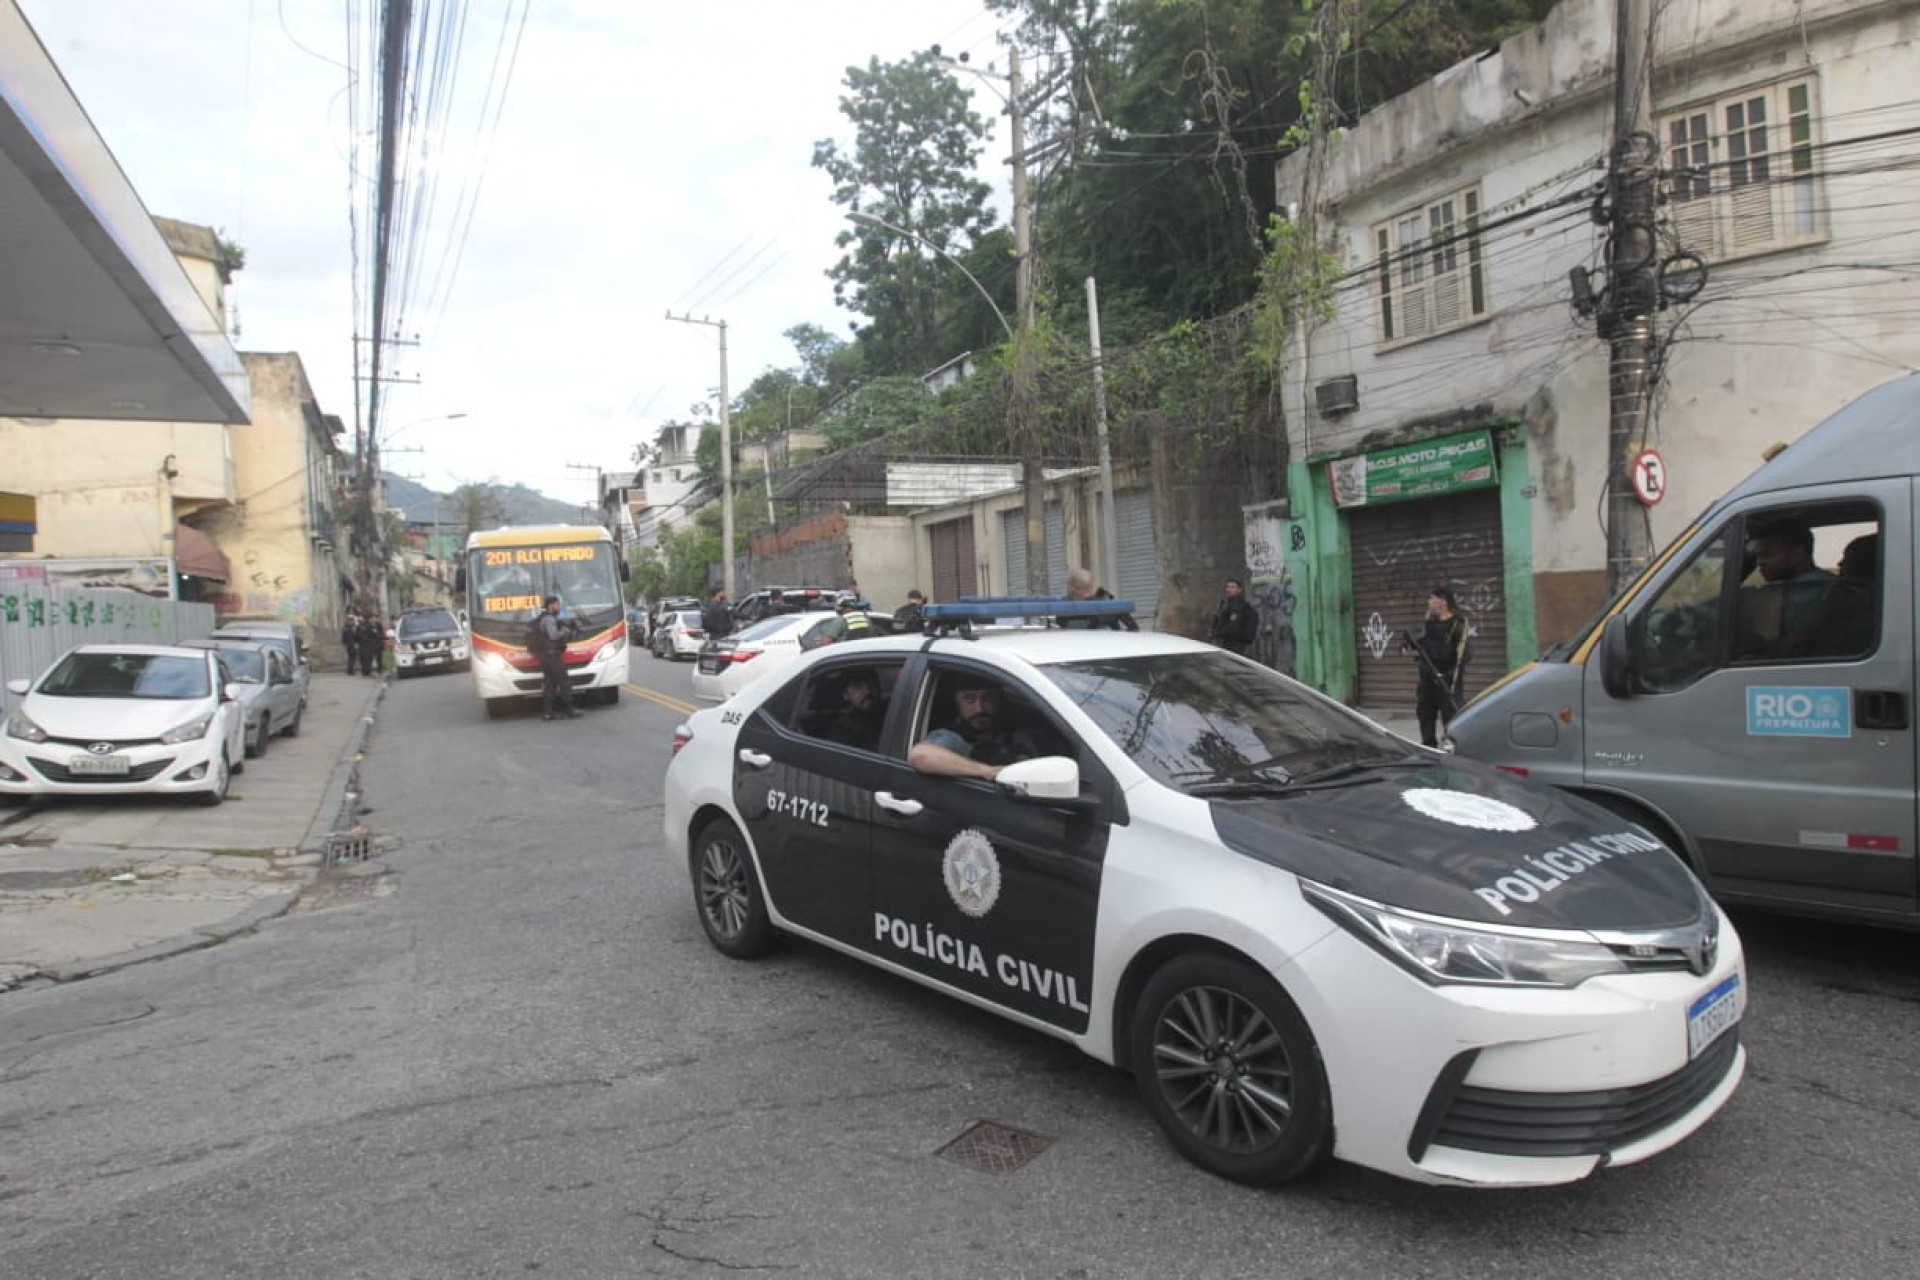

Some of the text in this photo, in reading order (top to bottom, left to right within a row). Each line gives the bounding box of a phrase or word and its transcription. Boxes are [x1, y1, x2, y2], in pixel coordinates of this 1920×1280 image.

[1399, 449, 1438, 466] MOTO
[1646, 461, 1658, 492] E
[486, 550, 512, 566] 201
[1756, 693, 1814, 718] RIO
[720, 711, 743, 726] DAS
[1756, 719, 1842, 729] PREFEITURA
[766, 788, 829, 828] 67-1712
[1473, 832, 1664, 916] POLÍCIA CIVIL
[874, 912, 1090, 1014] POLÍCIA CIVIL
